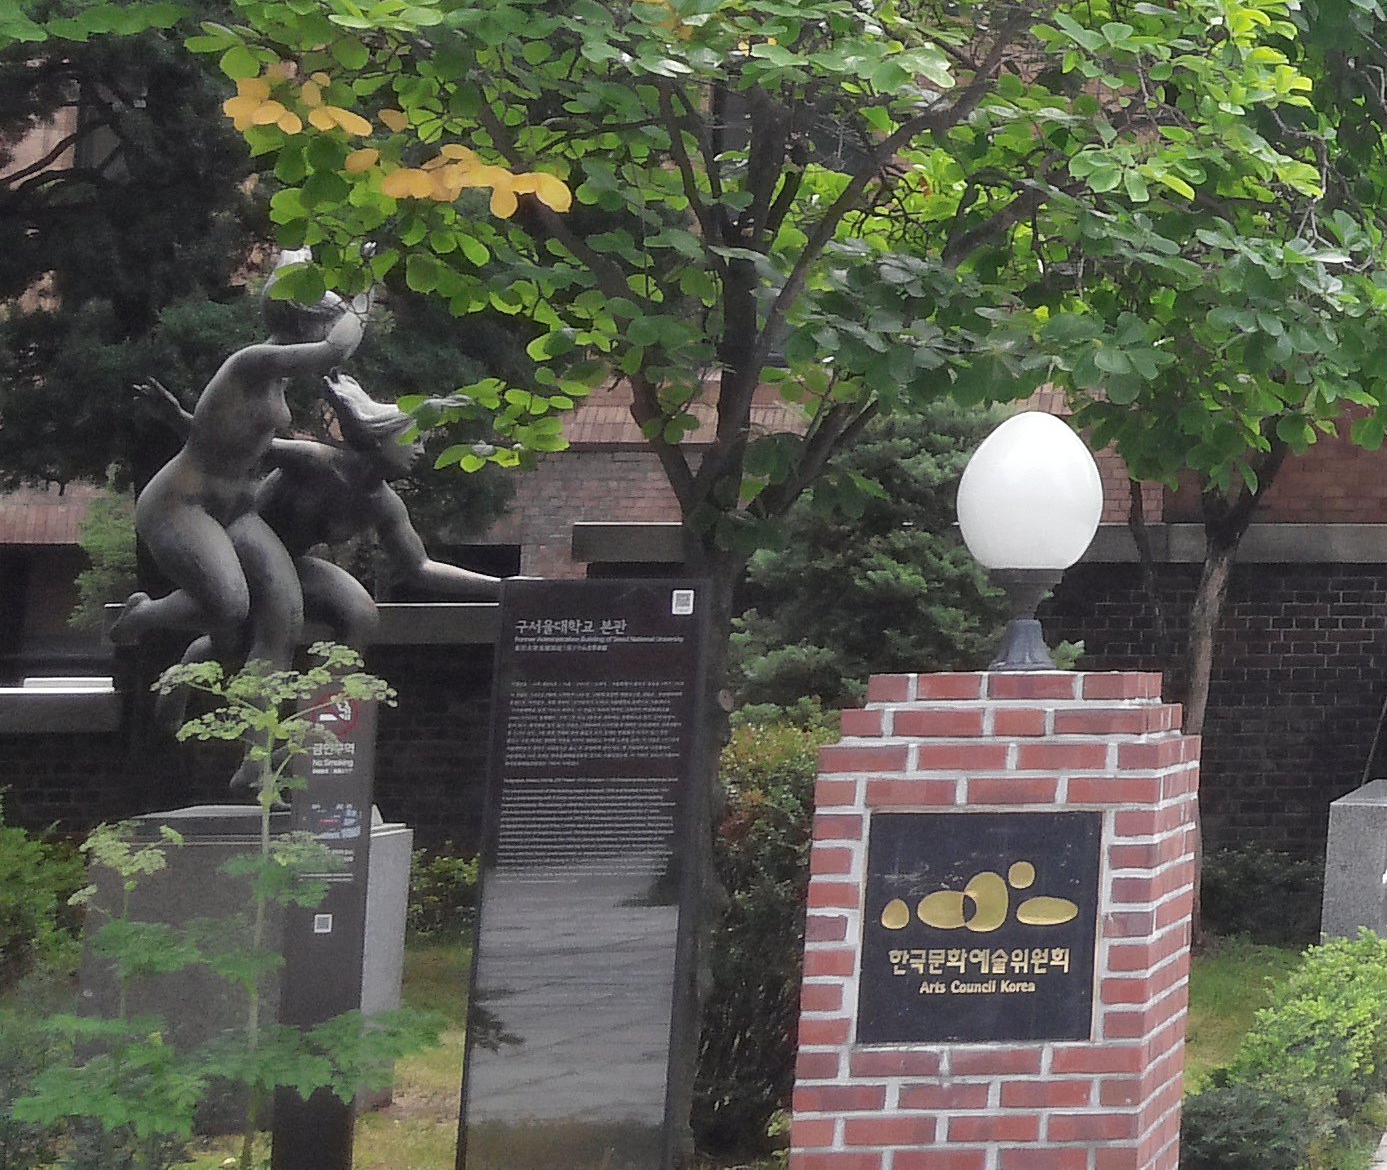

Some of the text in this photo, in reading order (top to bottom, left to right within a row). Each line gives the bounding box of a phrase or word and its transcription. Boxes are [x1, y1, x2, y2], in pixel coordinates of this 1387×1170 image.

[515, 619, 627, 635] 구서울대학교 본관
[312, 743, 355, 755] 금연구역
[312, 759, 354, 768] No Smoking
[888, 948, 1070, 976] 한국문화예술위원회
[919, 979, 1036, 995] Arts Council Korea
